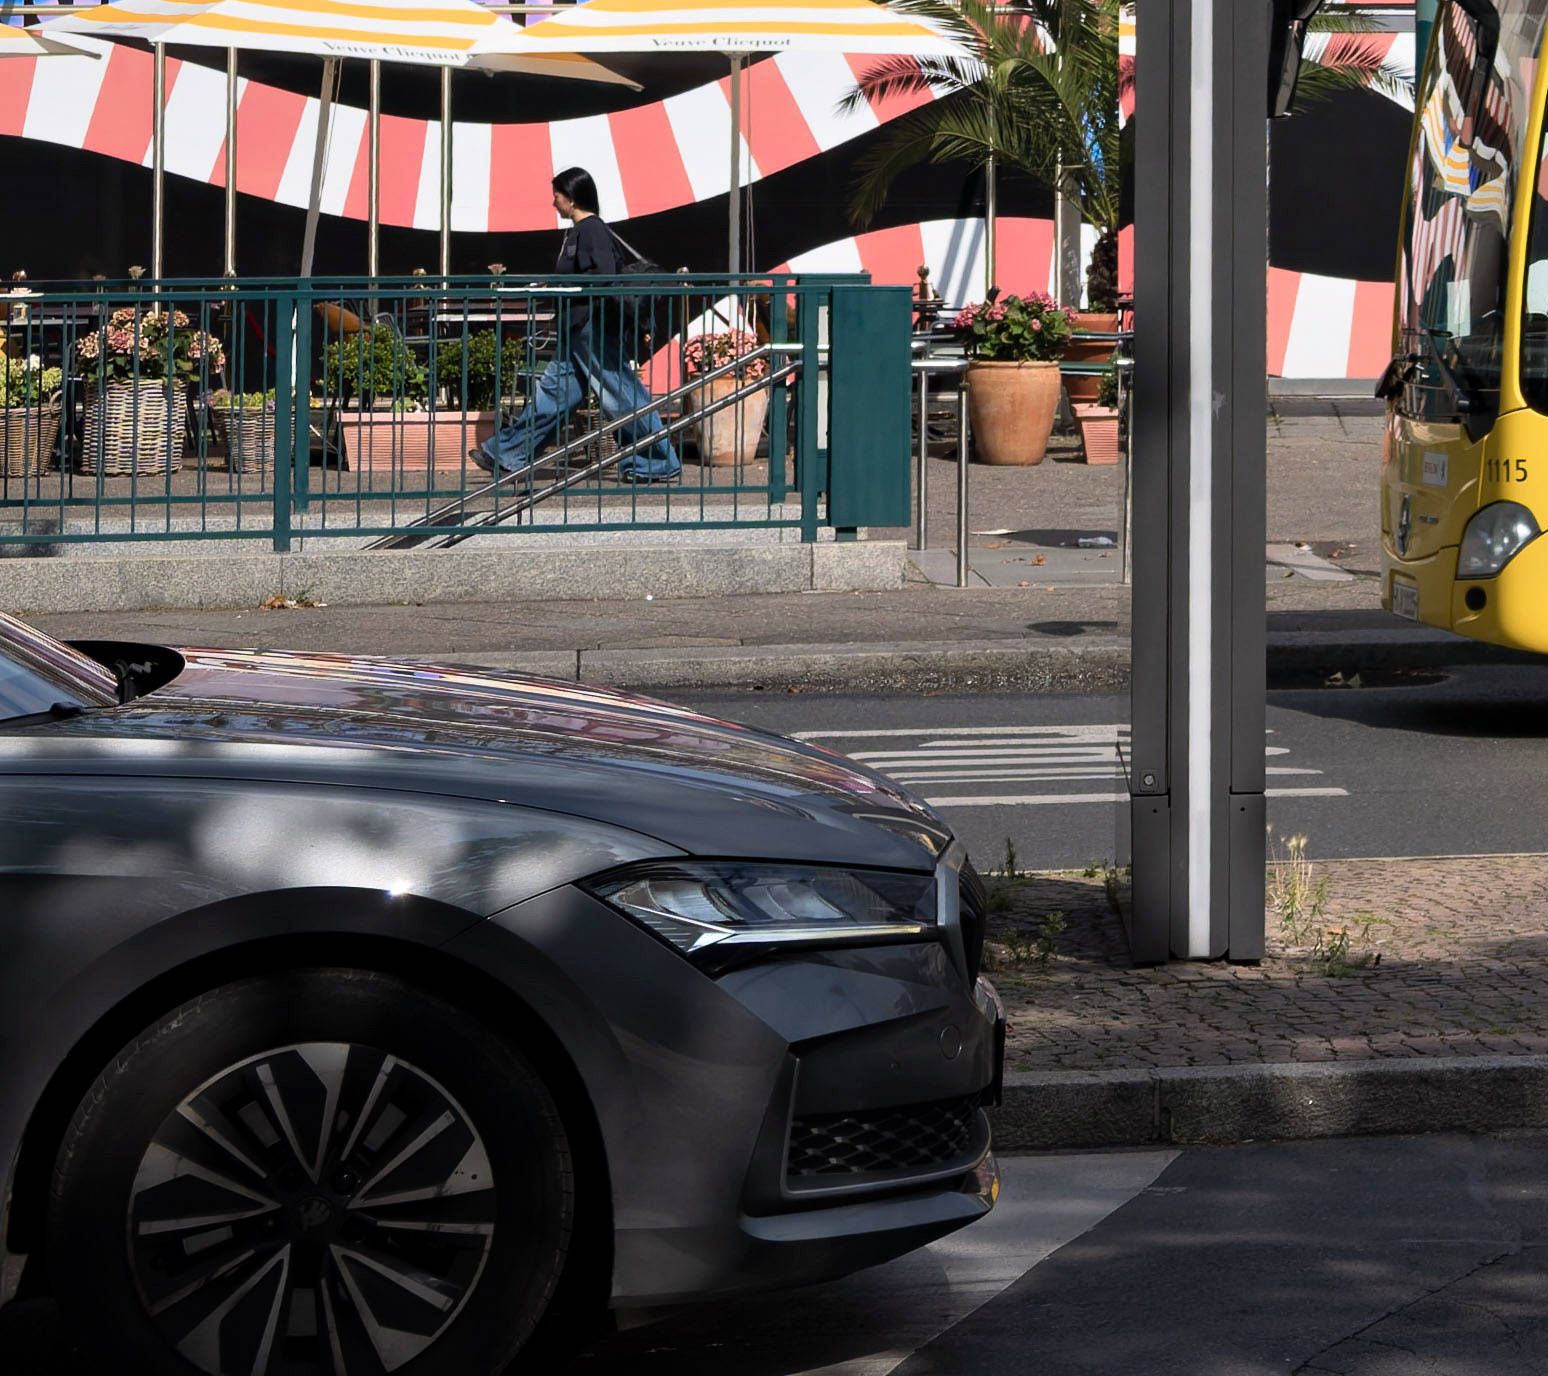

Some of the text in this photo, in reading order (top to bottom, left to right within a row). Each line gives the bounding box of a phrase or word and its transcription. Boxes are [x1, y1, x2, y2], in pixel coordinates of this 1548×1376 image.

[323, 41, 463, 62] Veuve Clicquot
[651, 36, 791, 49] Veuve Clicquot
[1487, 458, 1528, 483] 1115
